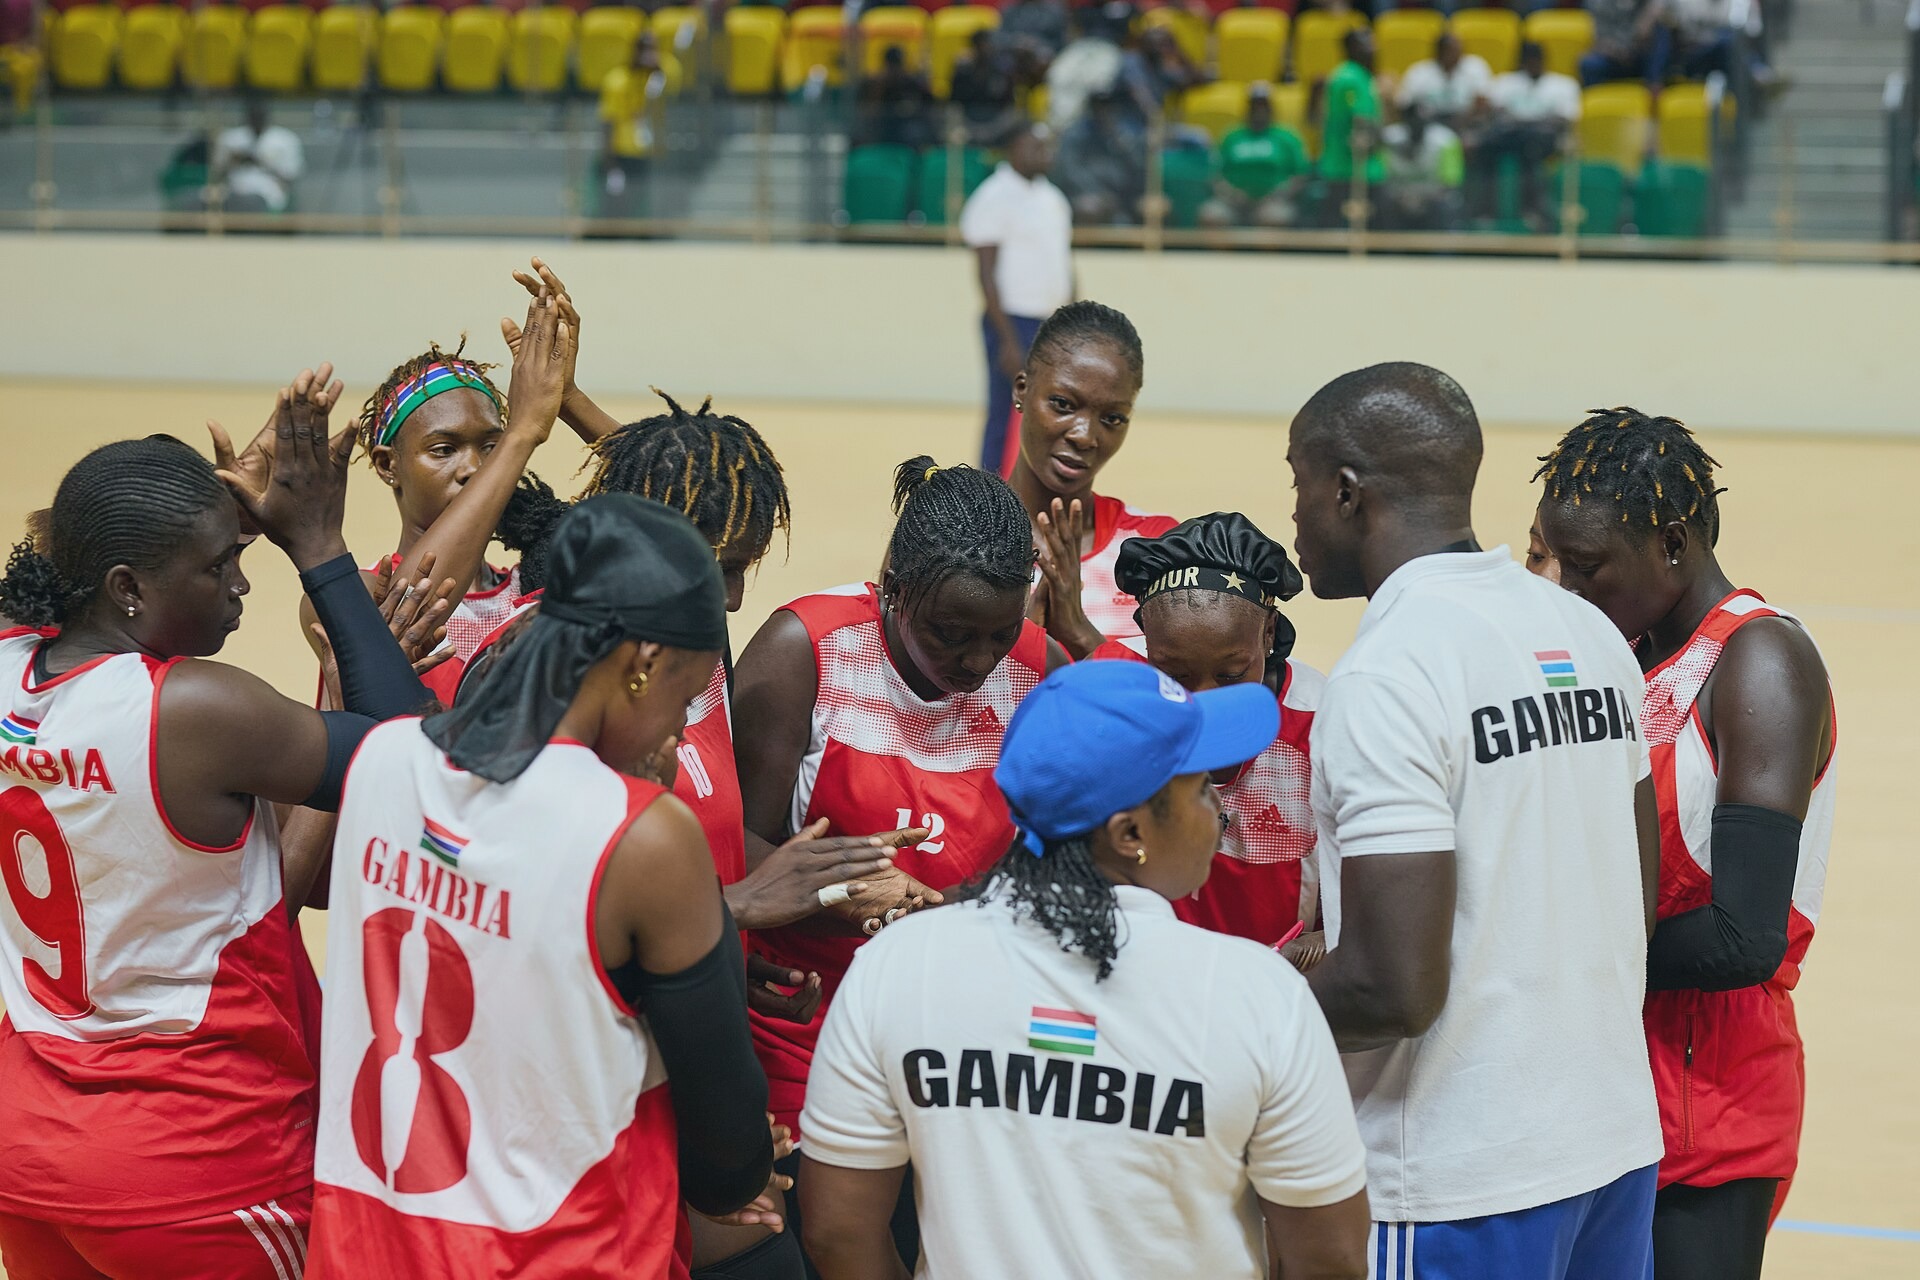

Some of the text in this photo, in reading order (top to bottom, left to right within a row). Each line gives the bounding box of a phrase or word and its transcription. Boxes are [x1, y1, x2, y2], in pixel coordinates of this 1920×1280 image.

[1471, 687, 1637, 763] GAMBIA
[676, 743, 713, 799] 10
[896, 807, 945, 854] 12
[0, 786, 96, 1021] 9
[363, 837, 511, 939] GAMBIA
[351, 906, 474, 1194] 8
[902, 1049, 1205, 1137] GAMBIA
